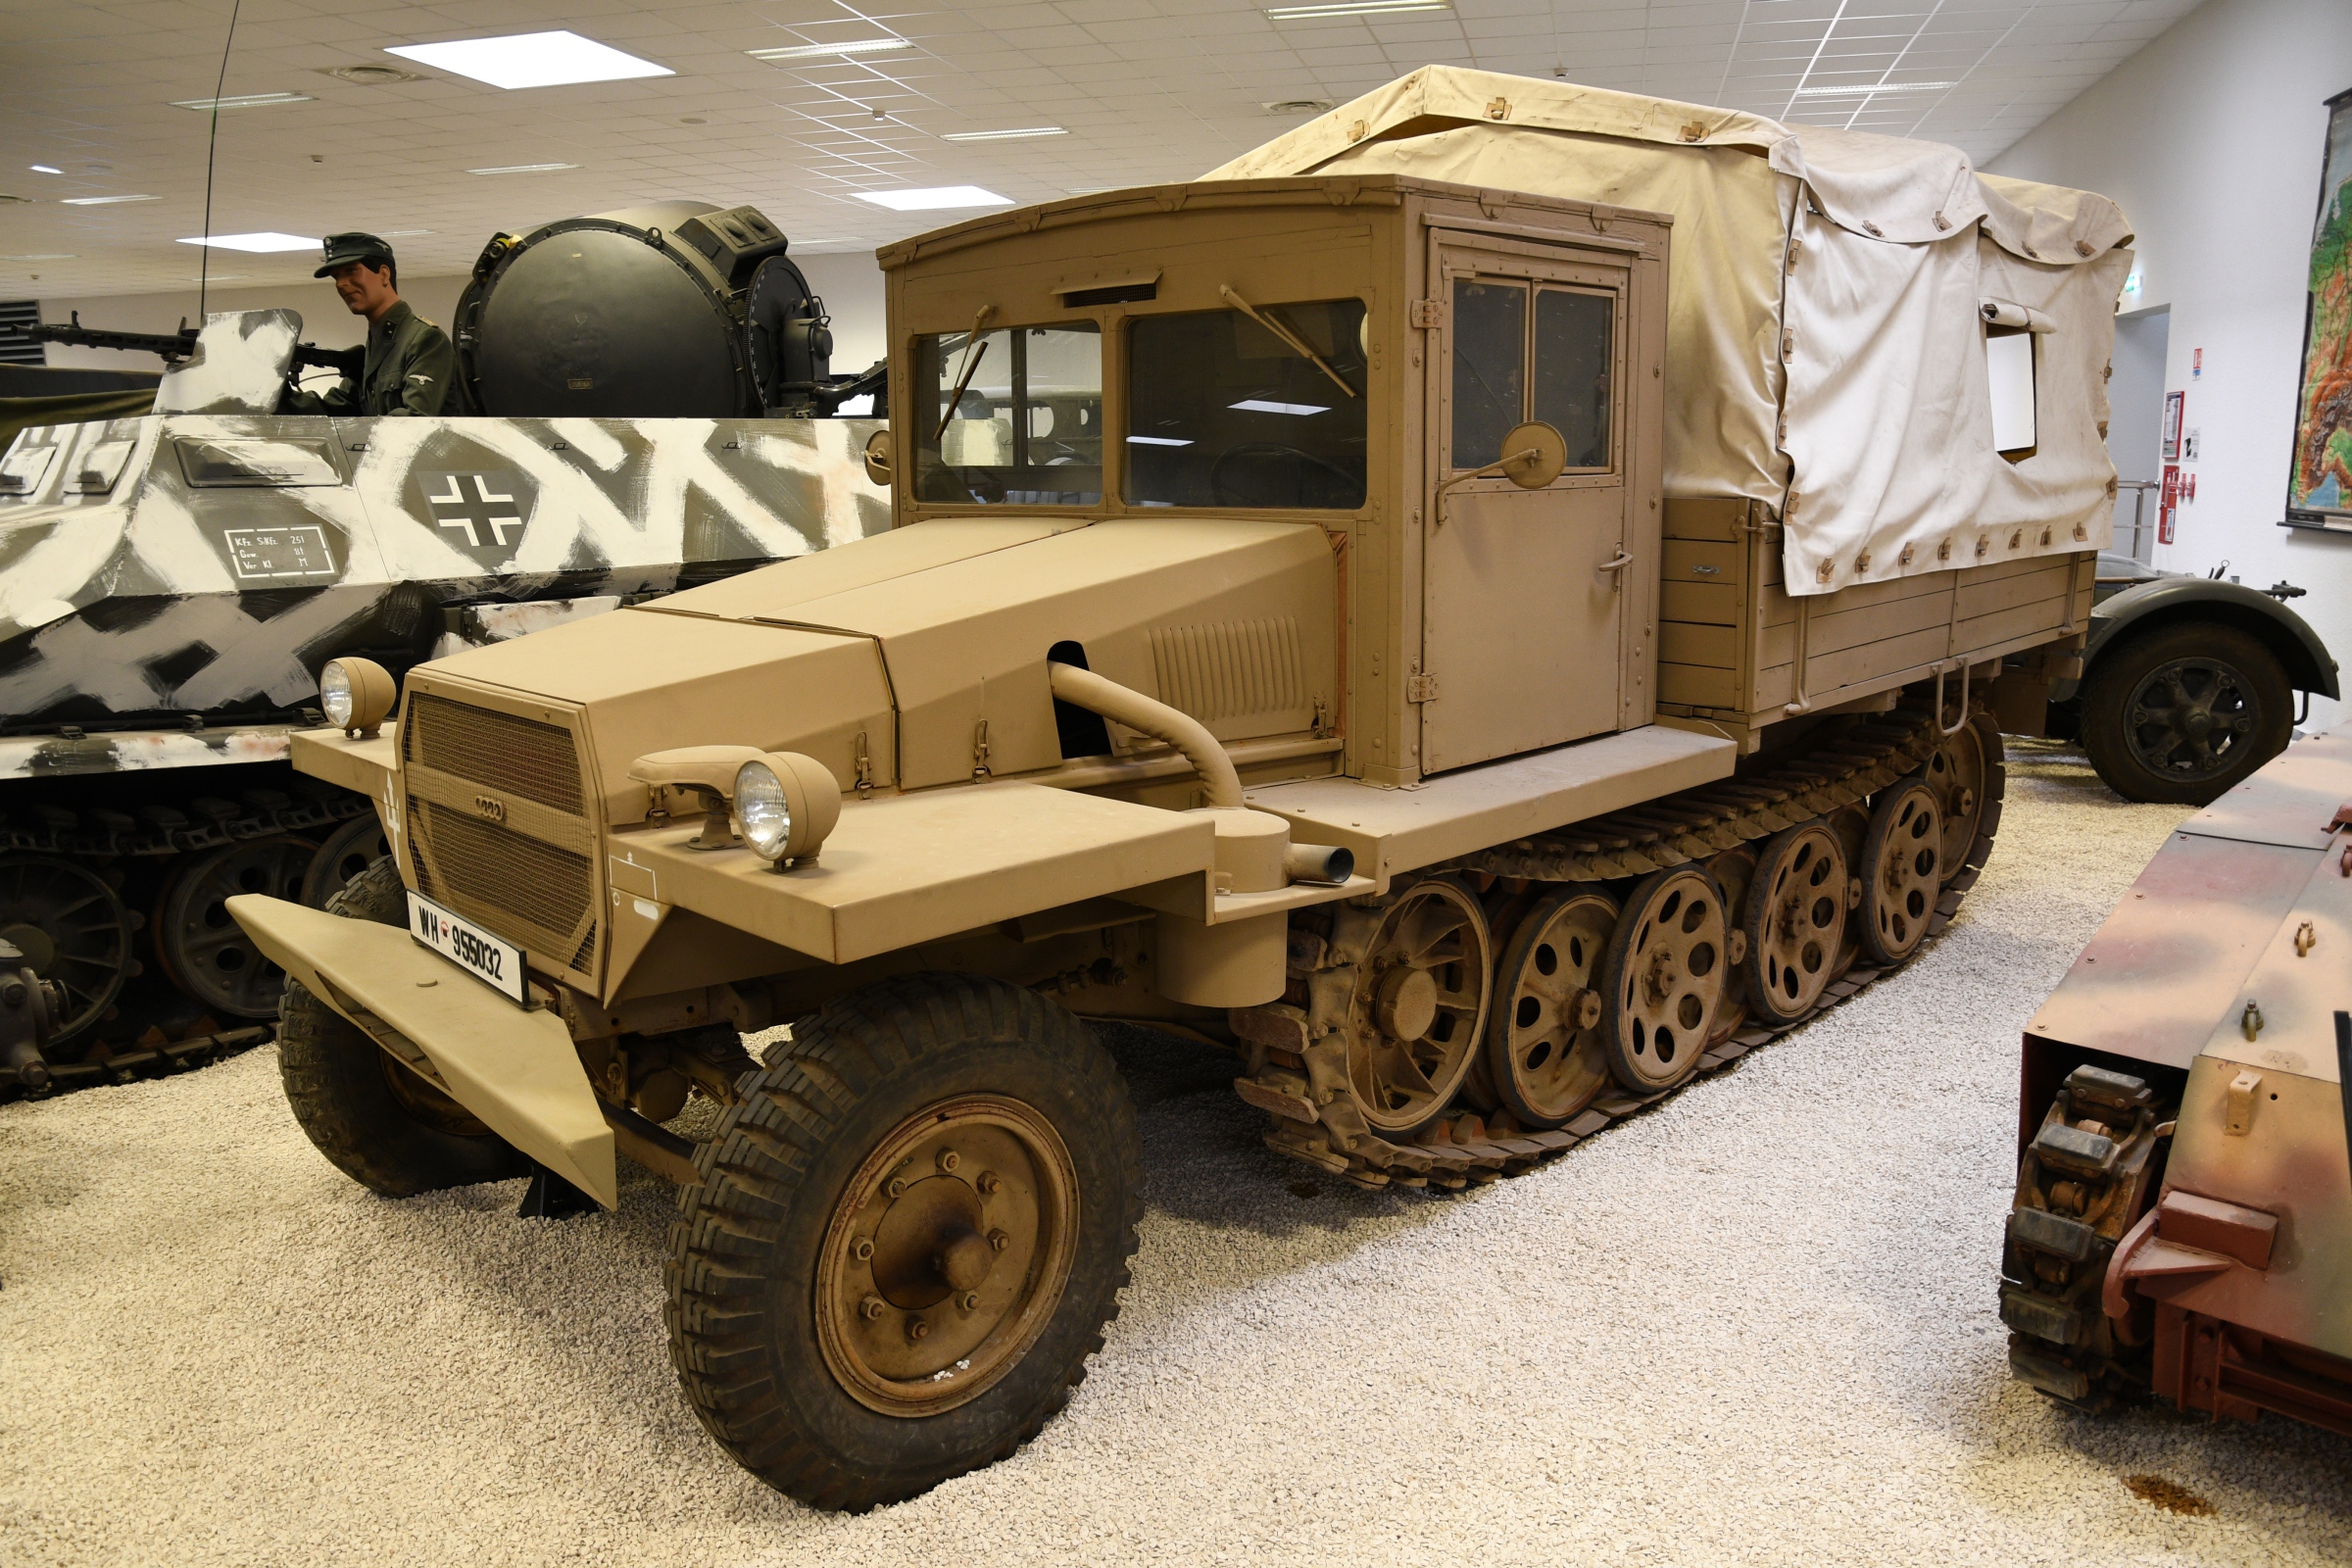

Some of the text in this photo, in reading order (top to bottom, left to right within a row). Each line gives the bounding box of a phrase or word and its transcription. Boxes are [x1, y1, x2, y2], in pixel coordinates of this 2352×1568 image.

[289, 535, 306, 545] 251
[297, 557, 309, 567] M
[418, 905, 504, 982] WH 955032
